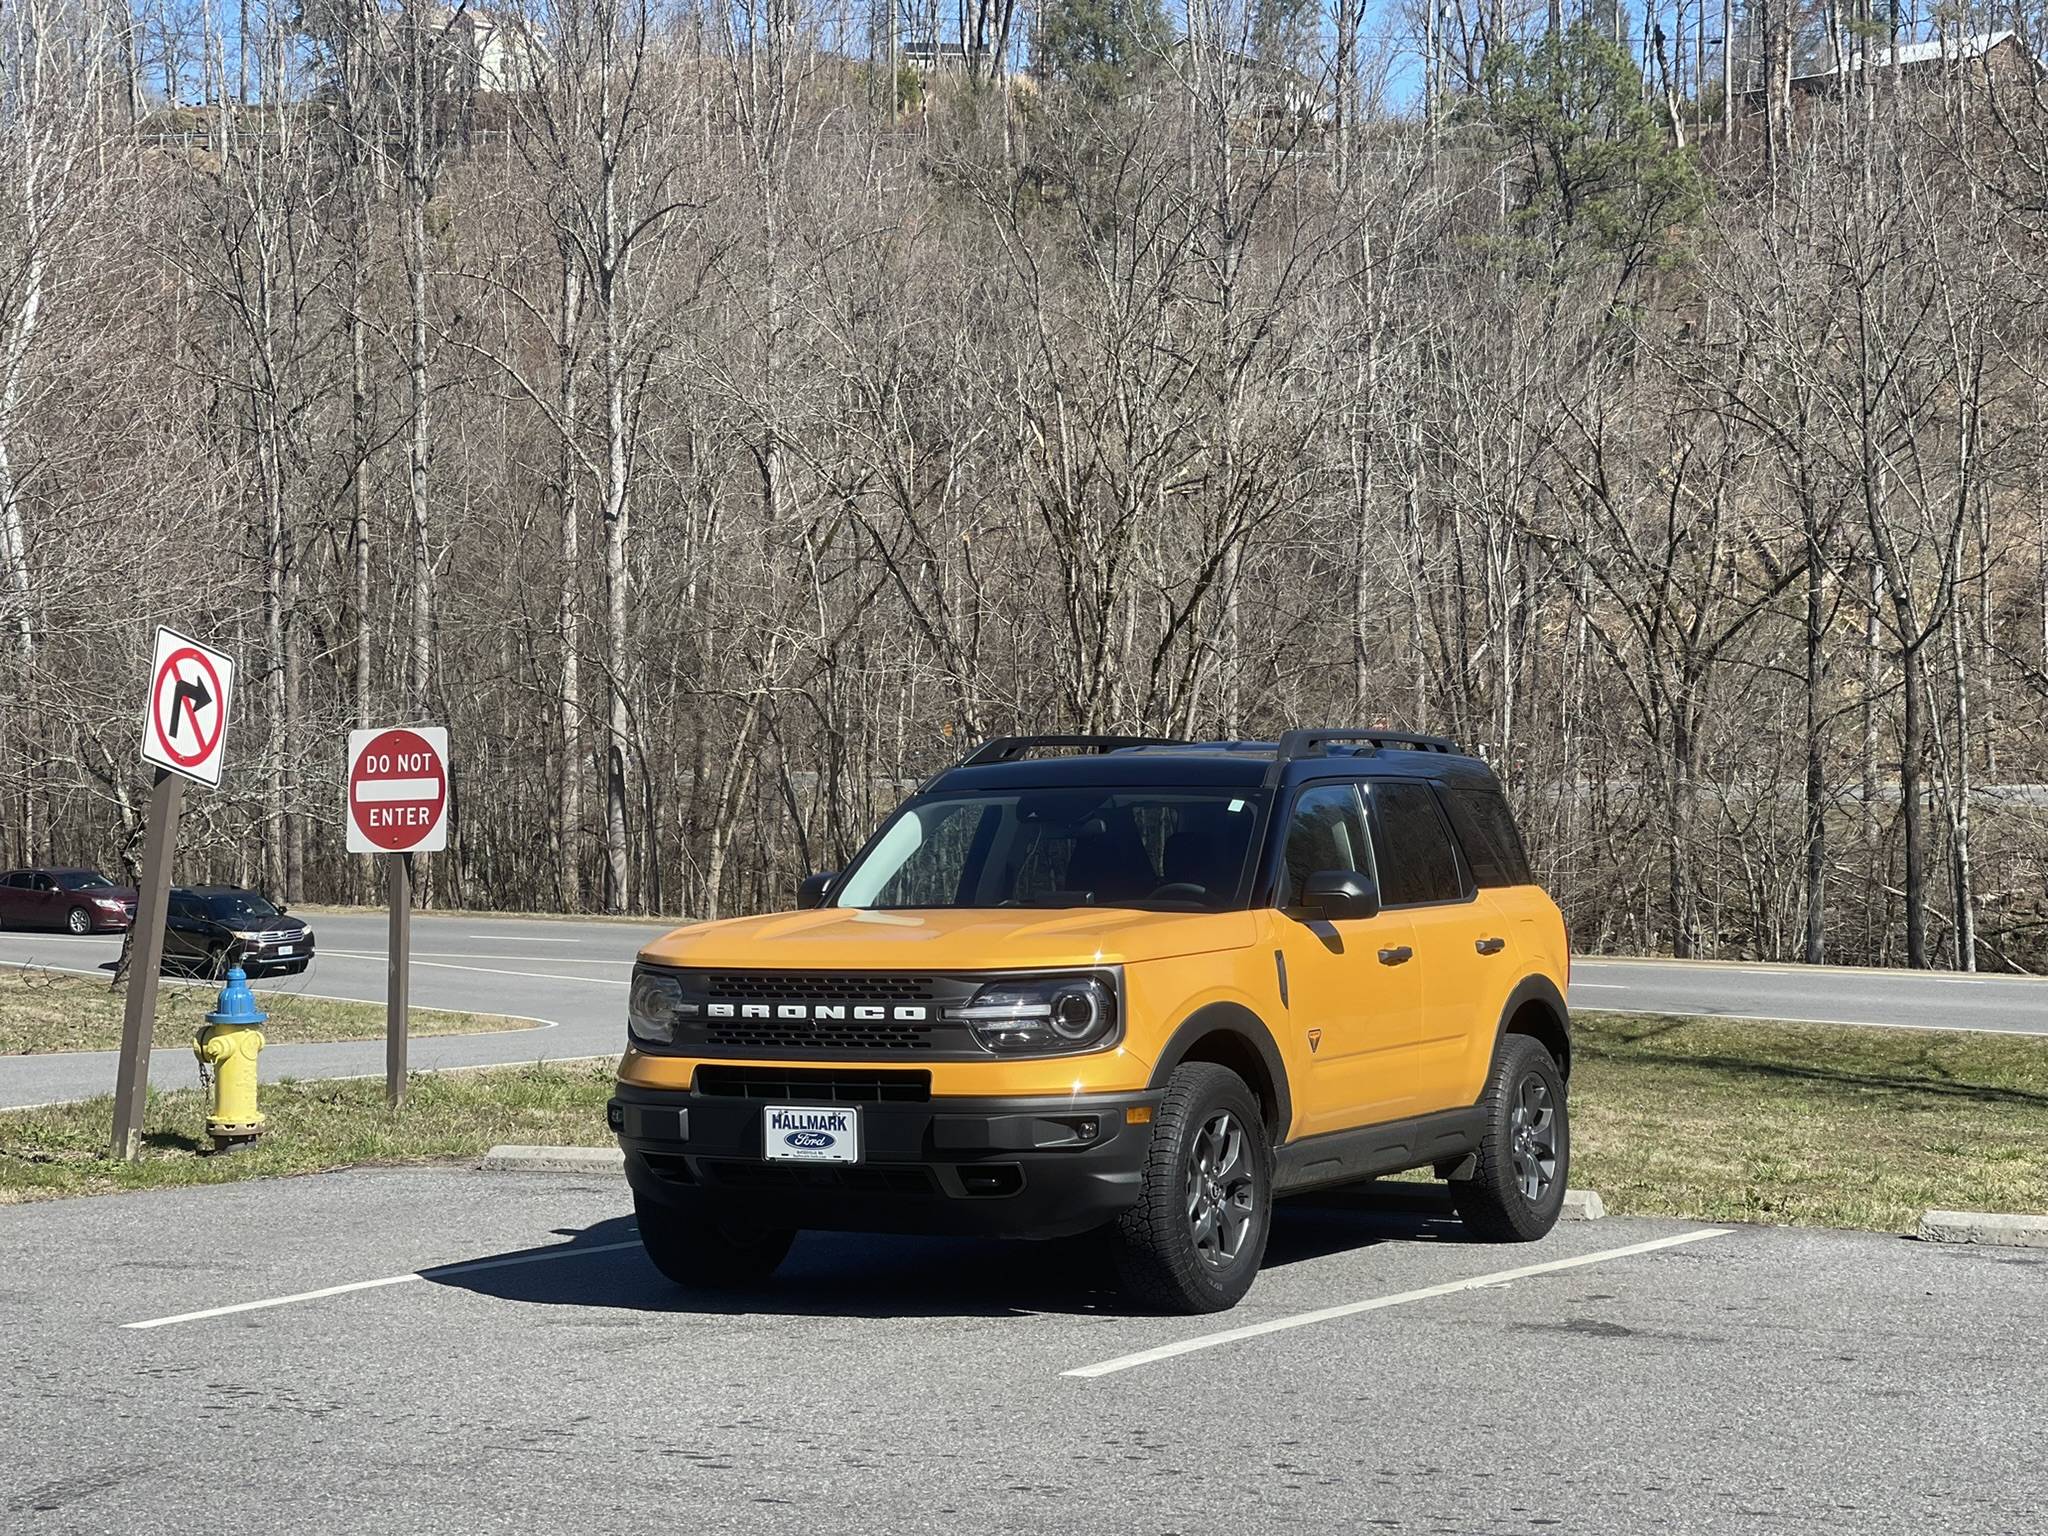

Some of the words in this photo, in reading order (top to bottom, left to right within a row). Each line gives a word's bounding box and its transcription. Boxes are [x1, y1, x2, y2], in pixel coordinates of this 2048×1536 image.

[366, 754, 390, 774] DO
[397, 753, 432, 773] NOT
[369, 807, 430, 827] ENTER
[707, 1003, 927, 1021] BRONCO
[771, 1113, 848, 1132] HALLMARK
[794, 1132, 827, 1147] Ford
